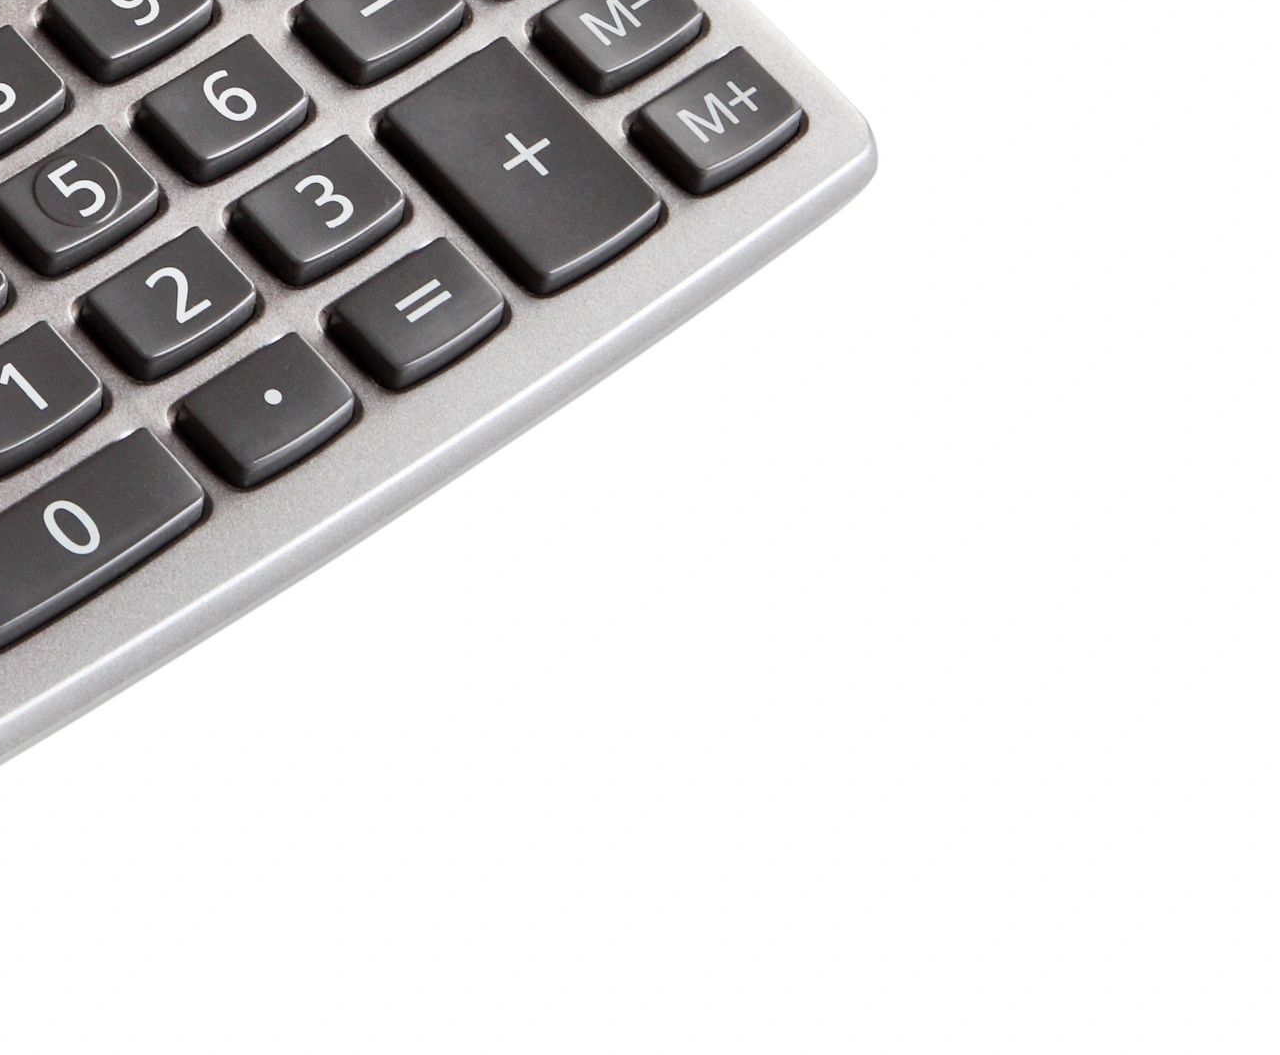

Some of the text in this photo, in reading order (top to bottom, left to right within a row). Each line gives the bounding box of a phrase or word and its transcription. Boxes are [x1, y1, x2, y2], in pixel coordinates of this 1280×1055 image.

[203, 69, 257, 122] 6
[677, 81, 758, 143] M+
[47, 159, 106, 218] 5
[294, 174, 354, 229] 3
[145, 266, 212, 324] 2
[0, 362, 49, 411] 1
[43, 499, 101, 555] 0
